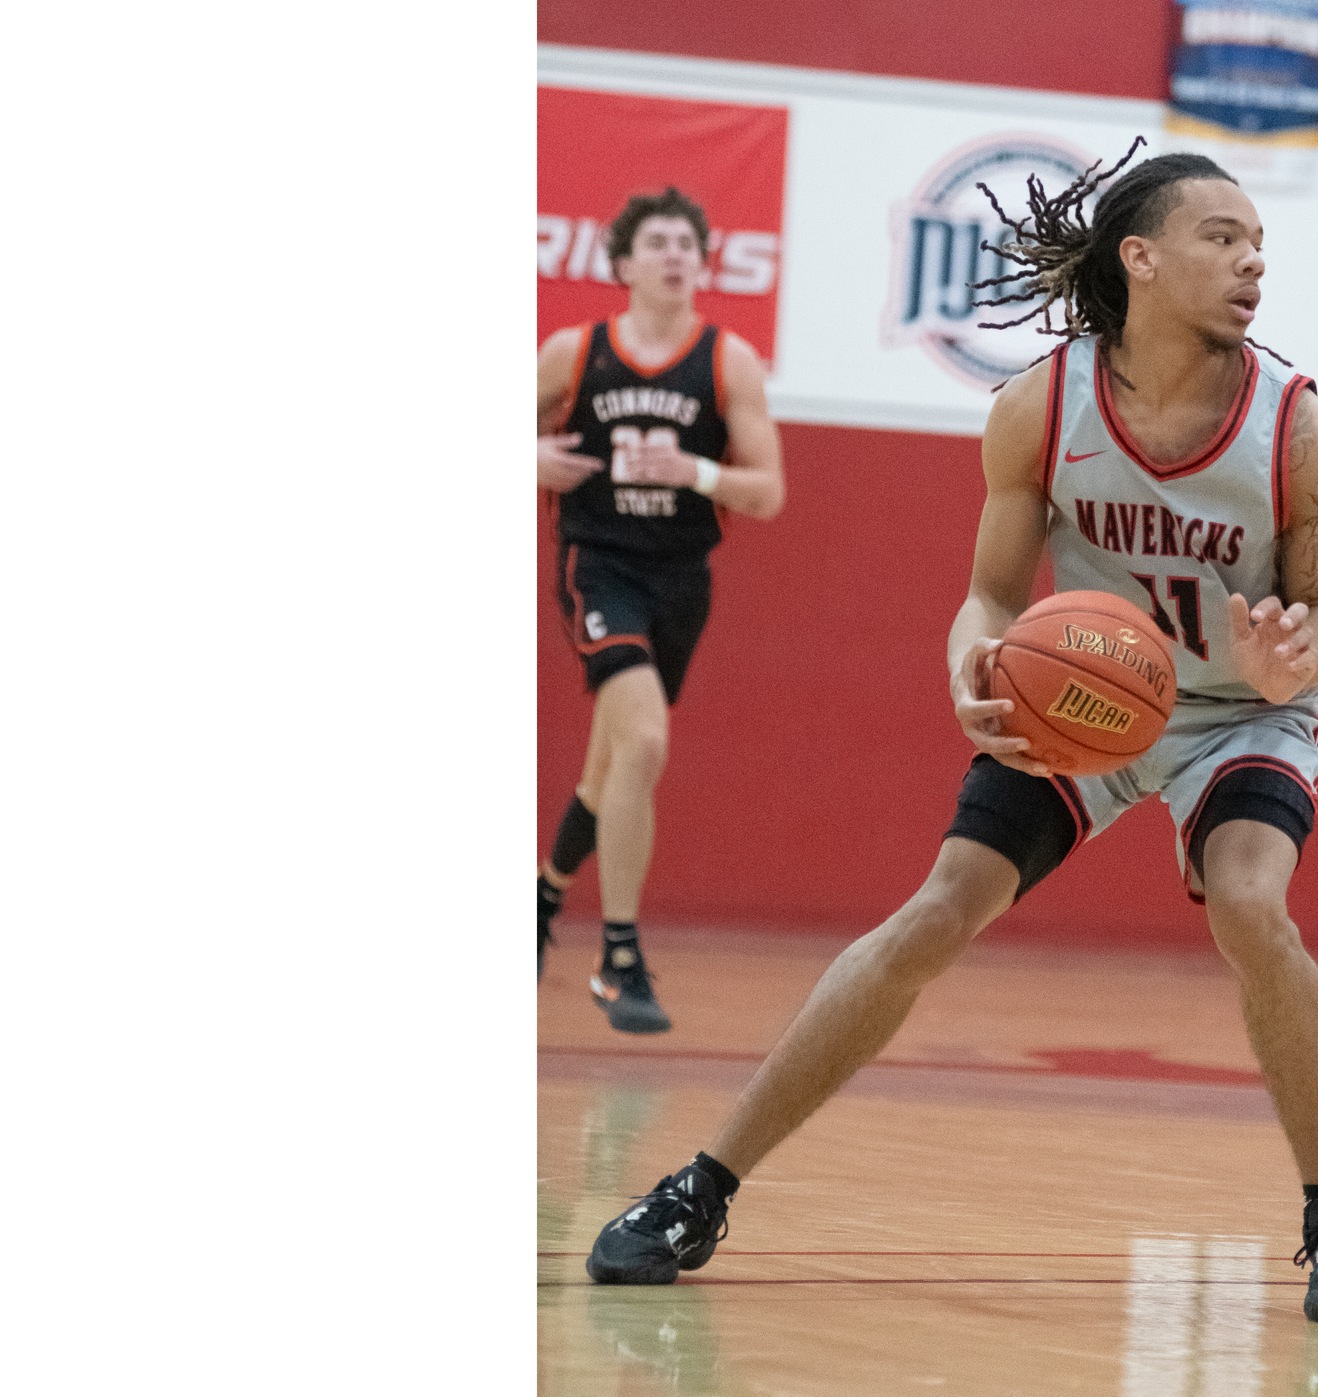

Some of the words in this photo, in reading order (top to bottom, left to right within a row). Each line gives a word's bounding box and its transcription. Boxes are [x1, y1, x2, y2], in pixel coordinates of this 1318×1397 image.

[537, 214, 777, 296] RIS
[1074, 498, 1245, 566] MAVERICKS
[1057, 624, 1169, 698] SPALDING
[1049, 679, 1134, 733] NJCAA
